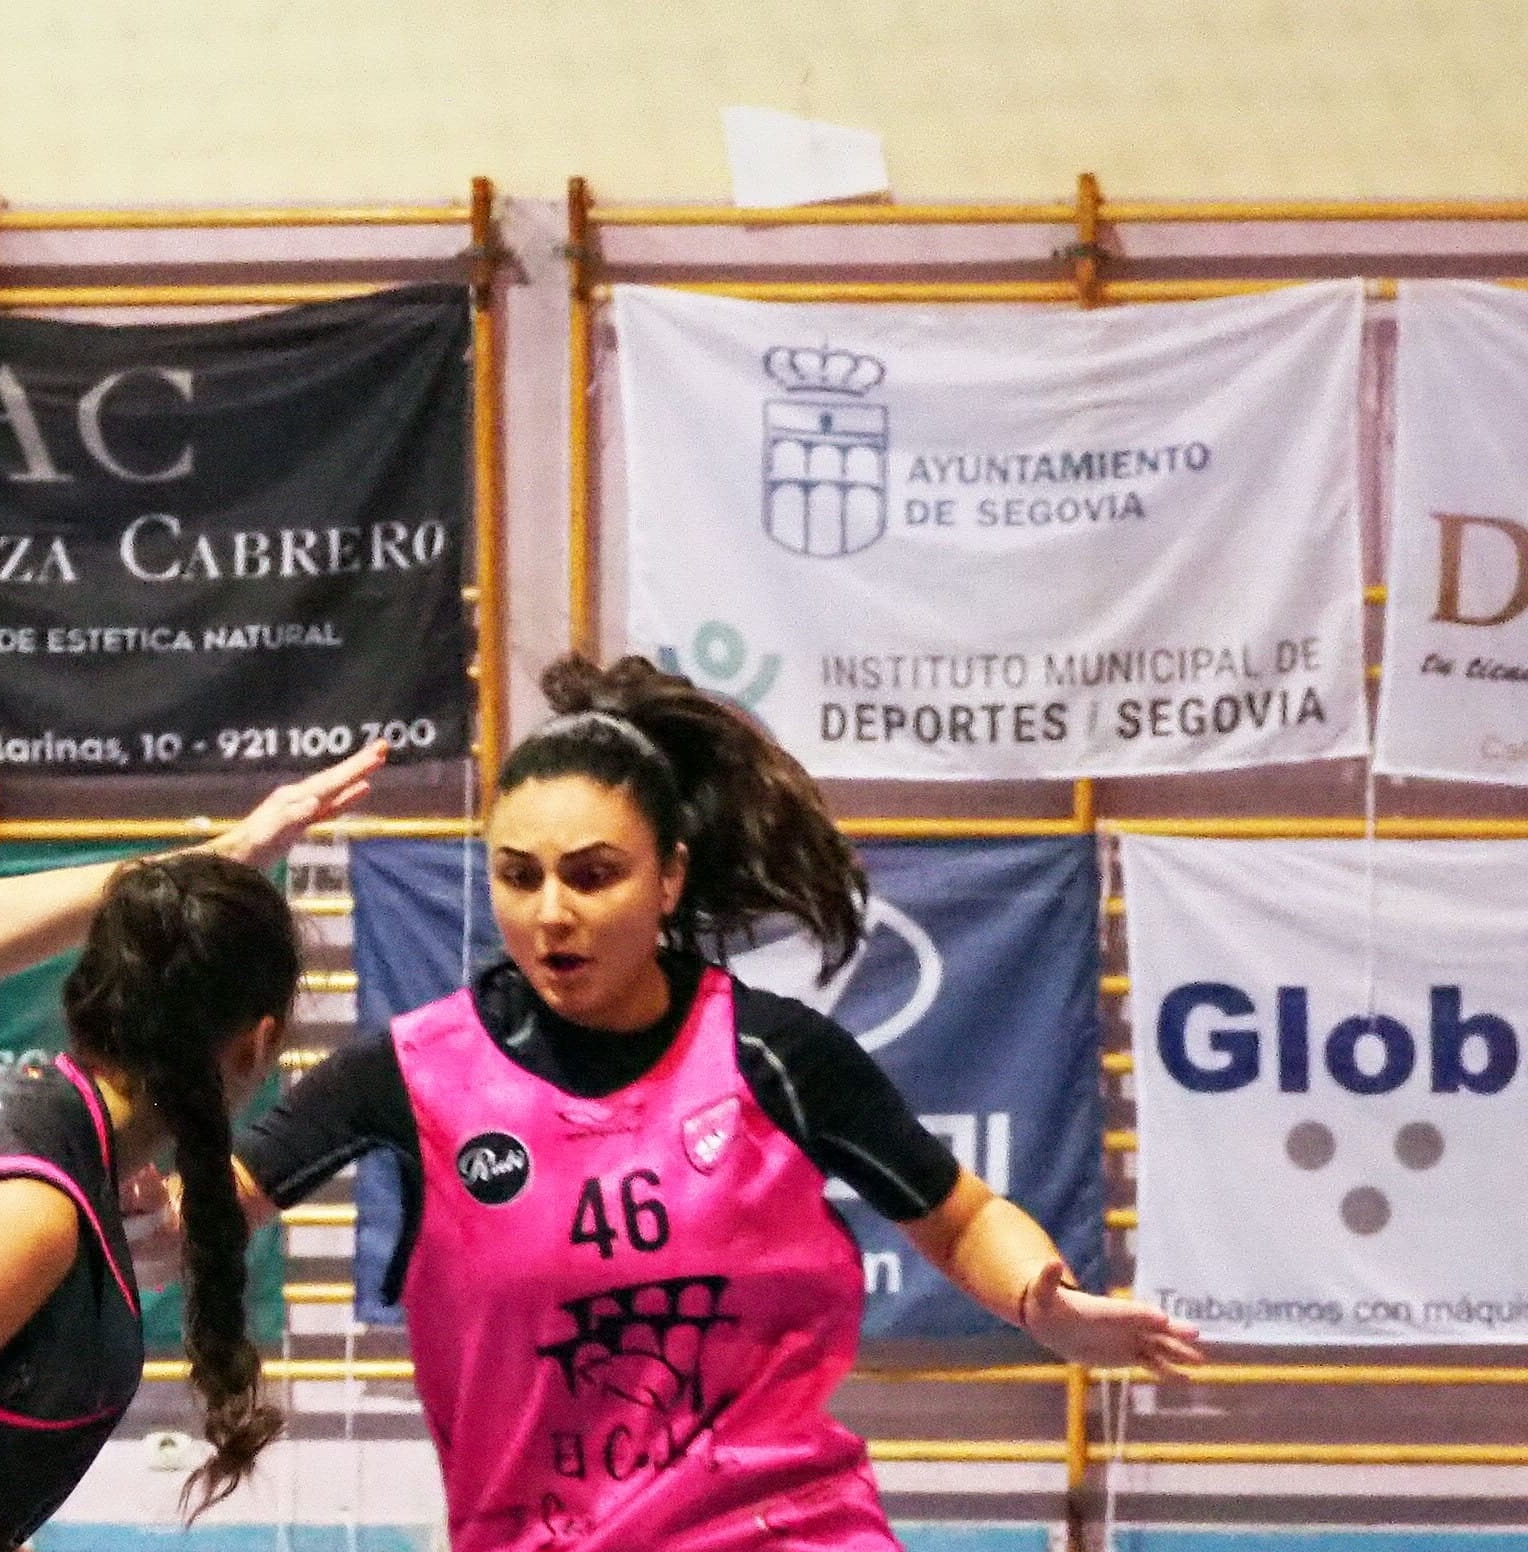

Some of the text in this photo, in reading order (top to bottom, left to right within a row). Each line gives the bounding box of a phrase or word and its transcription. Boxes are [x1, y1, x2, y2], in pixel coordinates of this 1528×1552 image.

[907, 441, 1212, 487] AYUNTAMIENTO
[906, 491, 1147, 527] DE SEGOVIA
[204, 623, 342, 652] NATURAL
[821, 638, 1321, 690] INSTITUTO MUNICIPAL DE
[820, 702, 1068, 744] DEPORTES
[1116, 687, 1326, 740] SEGOVIA
[218, 727, 278, 759] 921
[287, 725, 353, 757] 100
[1157, 982, 1519, 1095] Glob
[570, 1168, 671, 1260] 46
[1355, 1297, 1412, 1324] con
